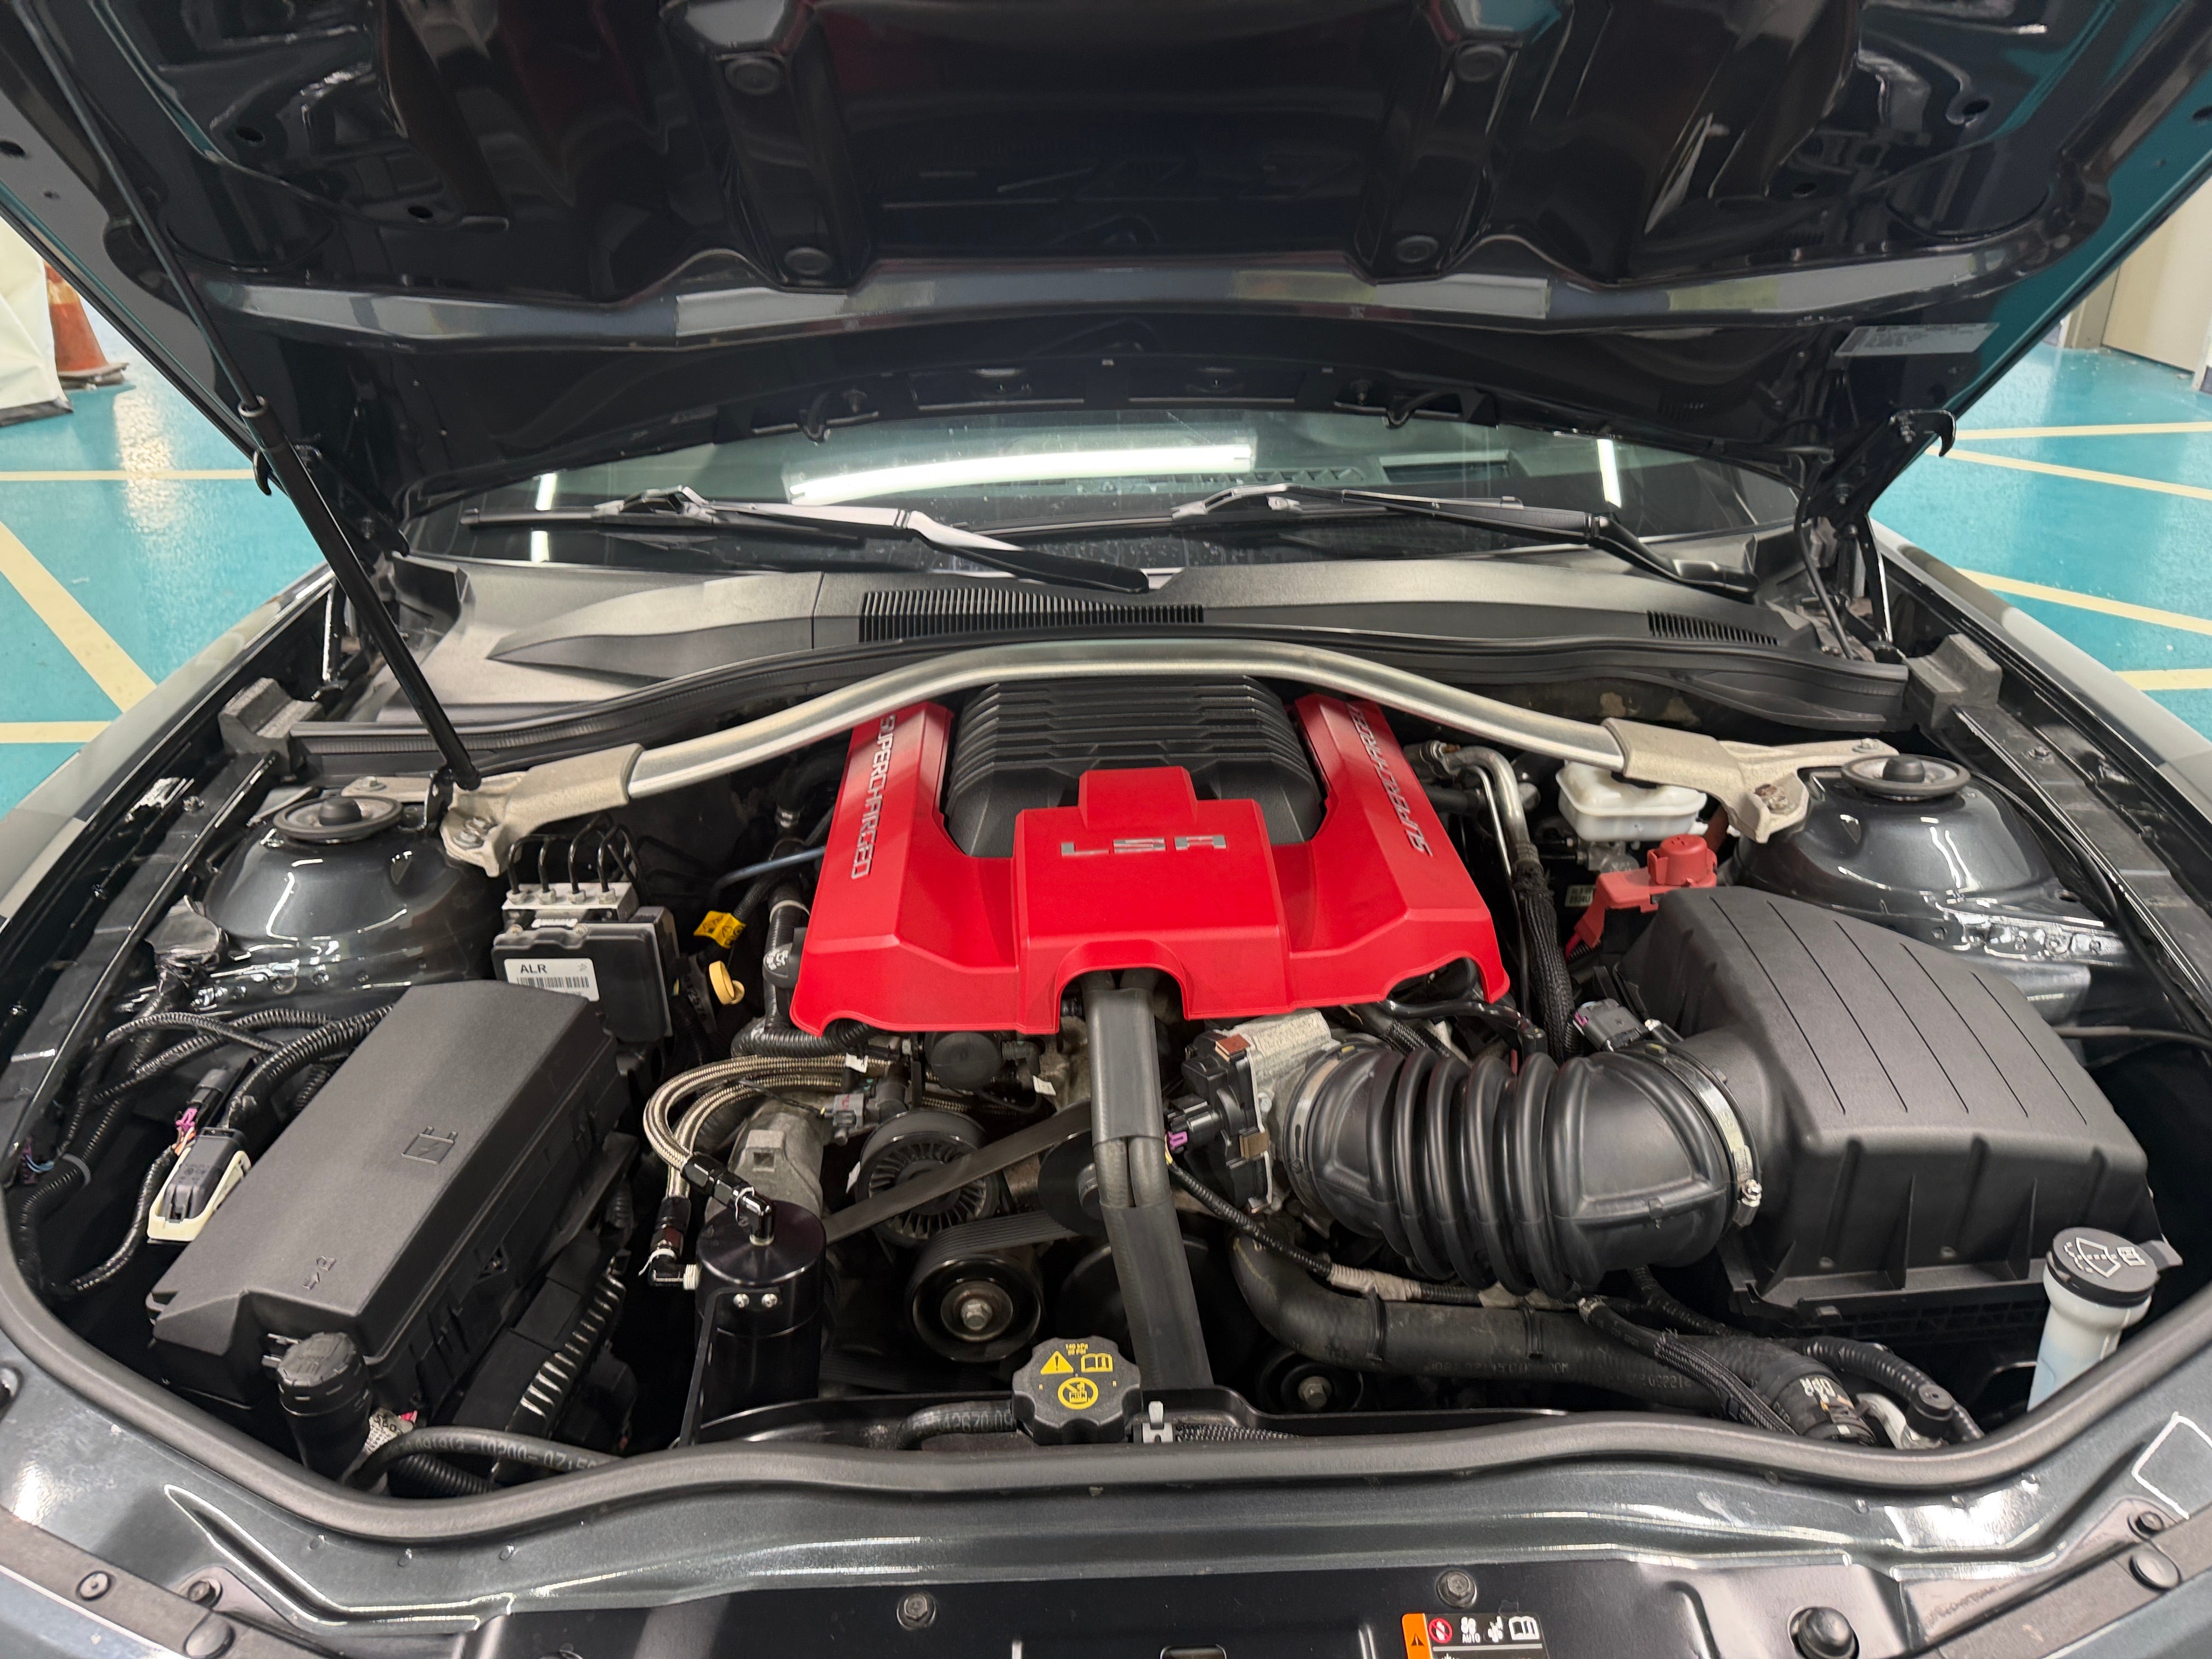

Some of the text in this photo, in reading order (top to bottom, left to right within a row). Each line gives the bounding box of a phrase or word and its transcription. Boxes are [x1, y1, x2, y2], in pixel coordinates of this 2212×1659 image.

[851, 714, 896, 879] SUPERCHARGED
[1060, 834, 1227, 857] LSA
[521, 964, 548, 974] ALR
[1462, 1633, 1481, 1643] AUTO
